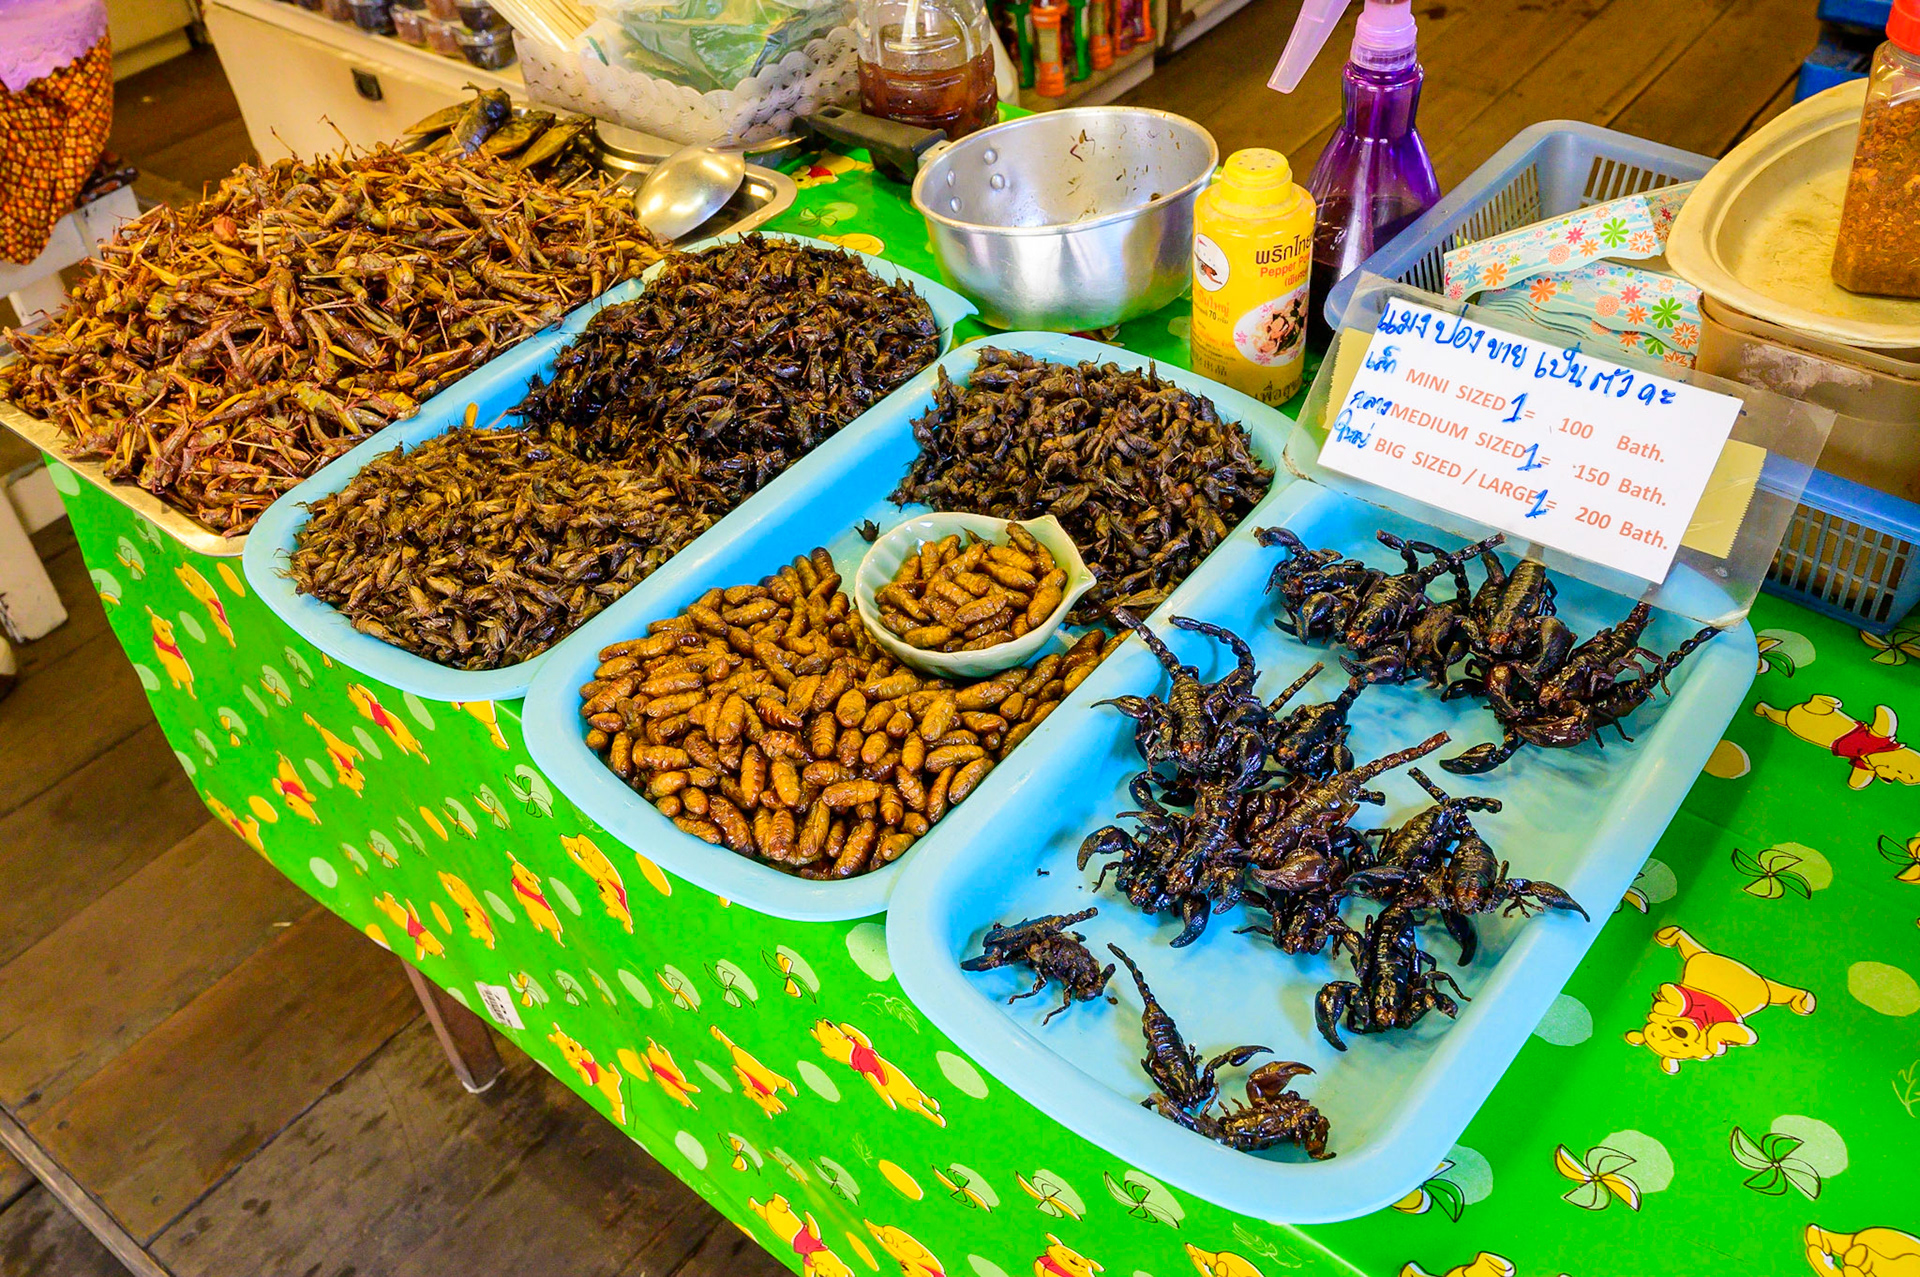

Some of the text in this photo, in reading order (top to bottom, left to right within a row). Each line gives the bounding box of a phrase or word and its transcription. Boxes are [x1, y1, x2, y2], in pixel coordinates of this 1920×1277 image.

[1208, 309, 1217, 321] 70
[1260, 262, 1296, 278] Pepper
[1390, 403, 1469, 440] MEDIUM
[1475, 432, 1526, 459] SIZED
[1574, 464, 1610, 487] 150
[1618, 477, 1667, 507] Bath.
[1406, 368, 1450, 394] MINI
[1456, 385, 1507, 412] SIZED
[1558, 417, 1594, 440] 100
[1616, 435, 1665, 463] Bath.
[1374, 437, 1406, 459] BIG
[1413, 450, 1462, 478] SIZED
[1478, 473, 1538, 505] LARGE
[1574, 506, 1612, 530] 200
[1619, 521, 1668, 551] Bath.
